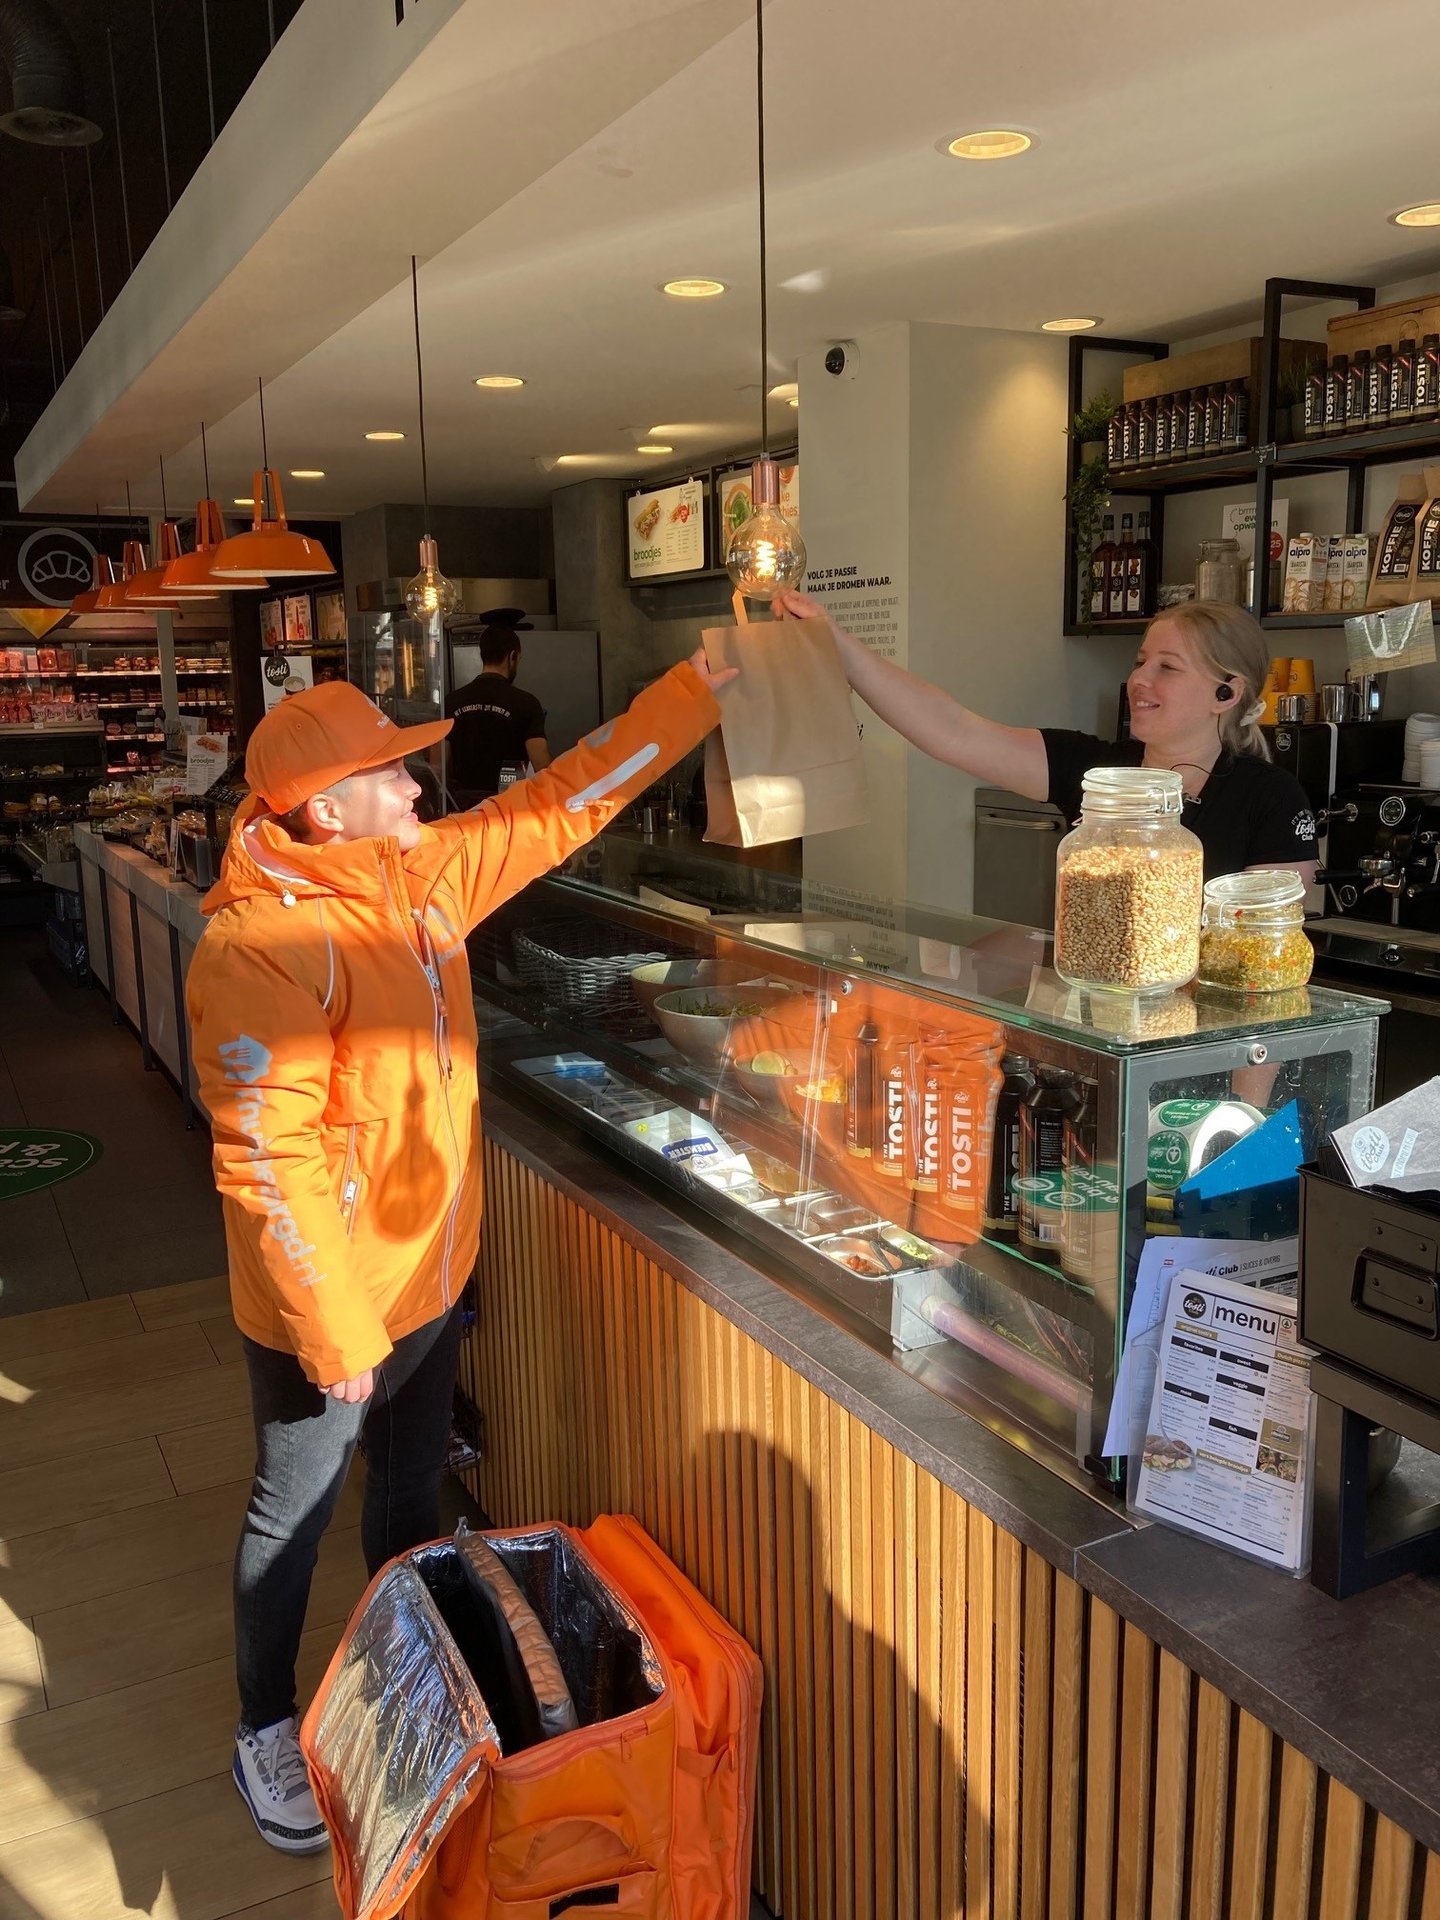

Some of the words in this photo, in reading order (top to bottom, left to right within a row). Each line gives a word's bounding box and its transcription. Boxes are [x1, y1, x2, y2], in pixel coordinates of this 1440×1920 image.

[1369, 373, 1378, 414] TOSTI
[1390, 368, 1399, 410] TOSTI
[1416, 363, 1426, 406] TOSTI
[1325, 383, 1334, 422] TOSTI
[1156, 419, 1165, 453] TOSTI
[1187, 411, 1196, 447] TOSTI
[633, 545, 661, 561] broodjes
[1289, 547, 1311, 559] alpro
[1328, 547, 1343, 559] lpro
[1346, 547, 1367, 559] alpro
[1381, 525, 1403, 573] KOFFIE
[1421, 519, 1439, 571] KOFFIE
[807, 569, 825, 580] VOLG
[825, 568, 833, 579] JE
[834, 566, 858, 577] PASSIE
[807, 583, 827, 594] MAAK
[827, 582, 835, 591] JE
[836, 579, 866, 590] DROMEN
[867, 576, 892, 587] WAAR.
[266, 662, 289, 678] tosti
[500, 774, 517, 783] TOSTI
[888, 1081, 903, 1160] TOSTI
[924, 1093, 938, 1175] TOSTI
[952, 1107, 972, 1191] TOSTI
[1218, 1265, 1239, 1276] Club
[1258, 1258, 1263, 1267] &
[1184, 1299, 1206, 1313] tosti
[1216, 1305, 1276, 1335] menu
[1277, 1352, 1292, 1362] Dutch
[1233, 1381, 1248, 1390] veggie
